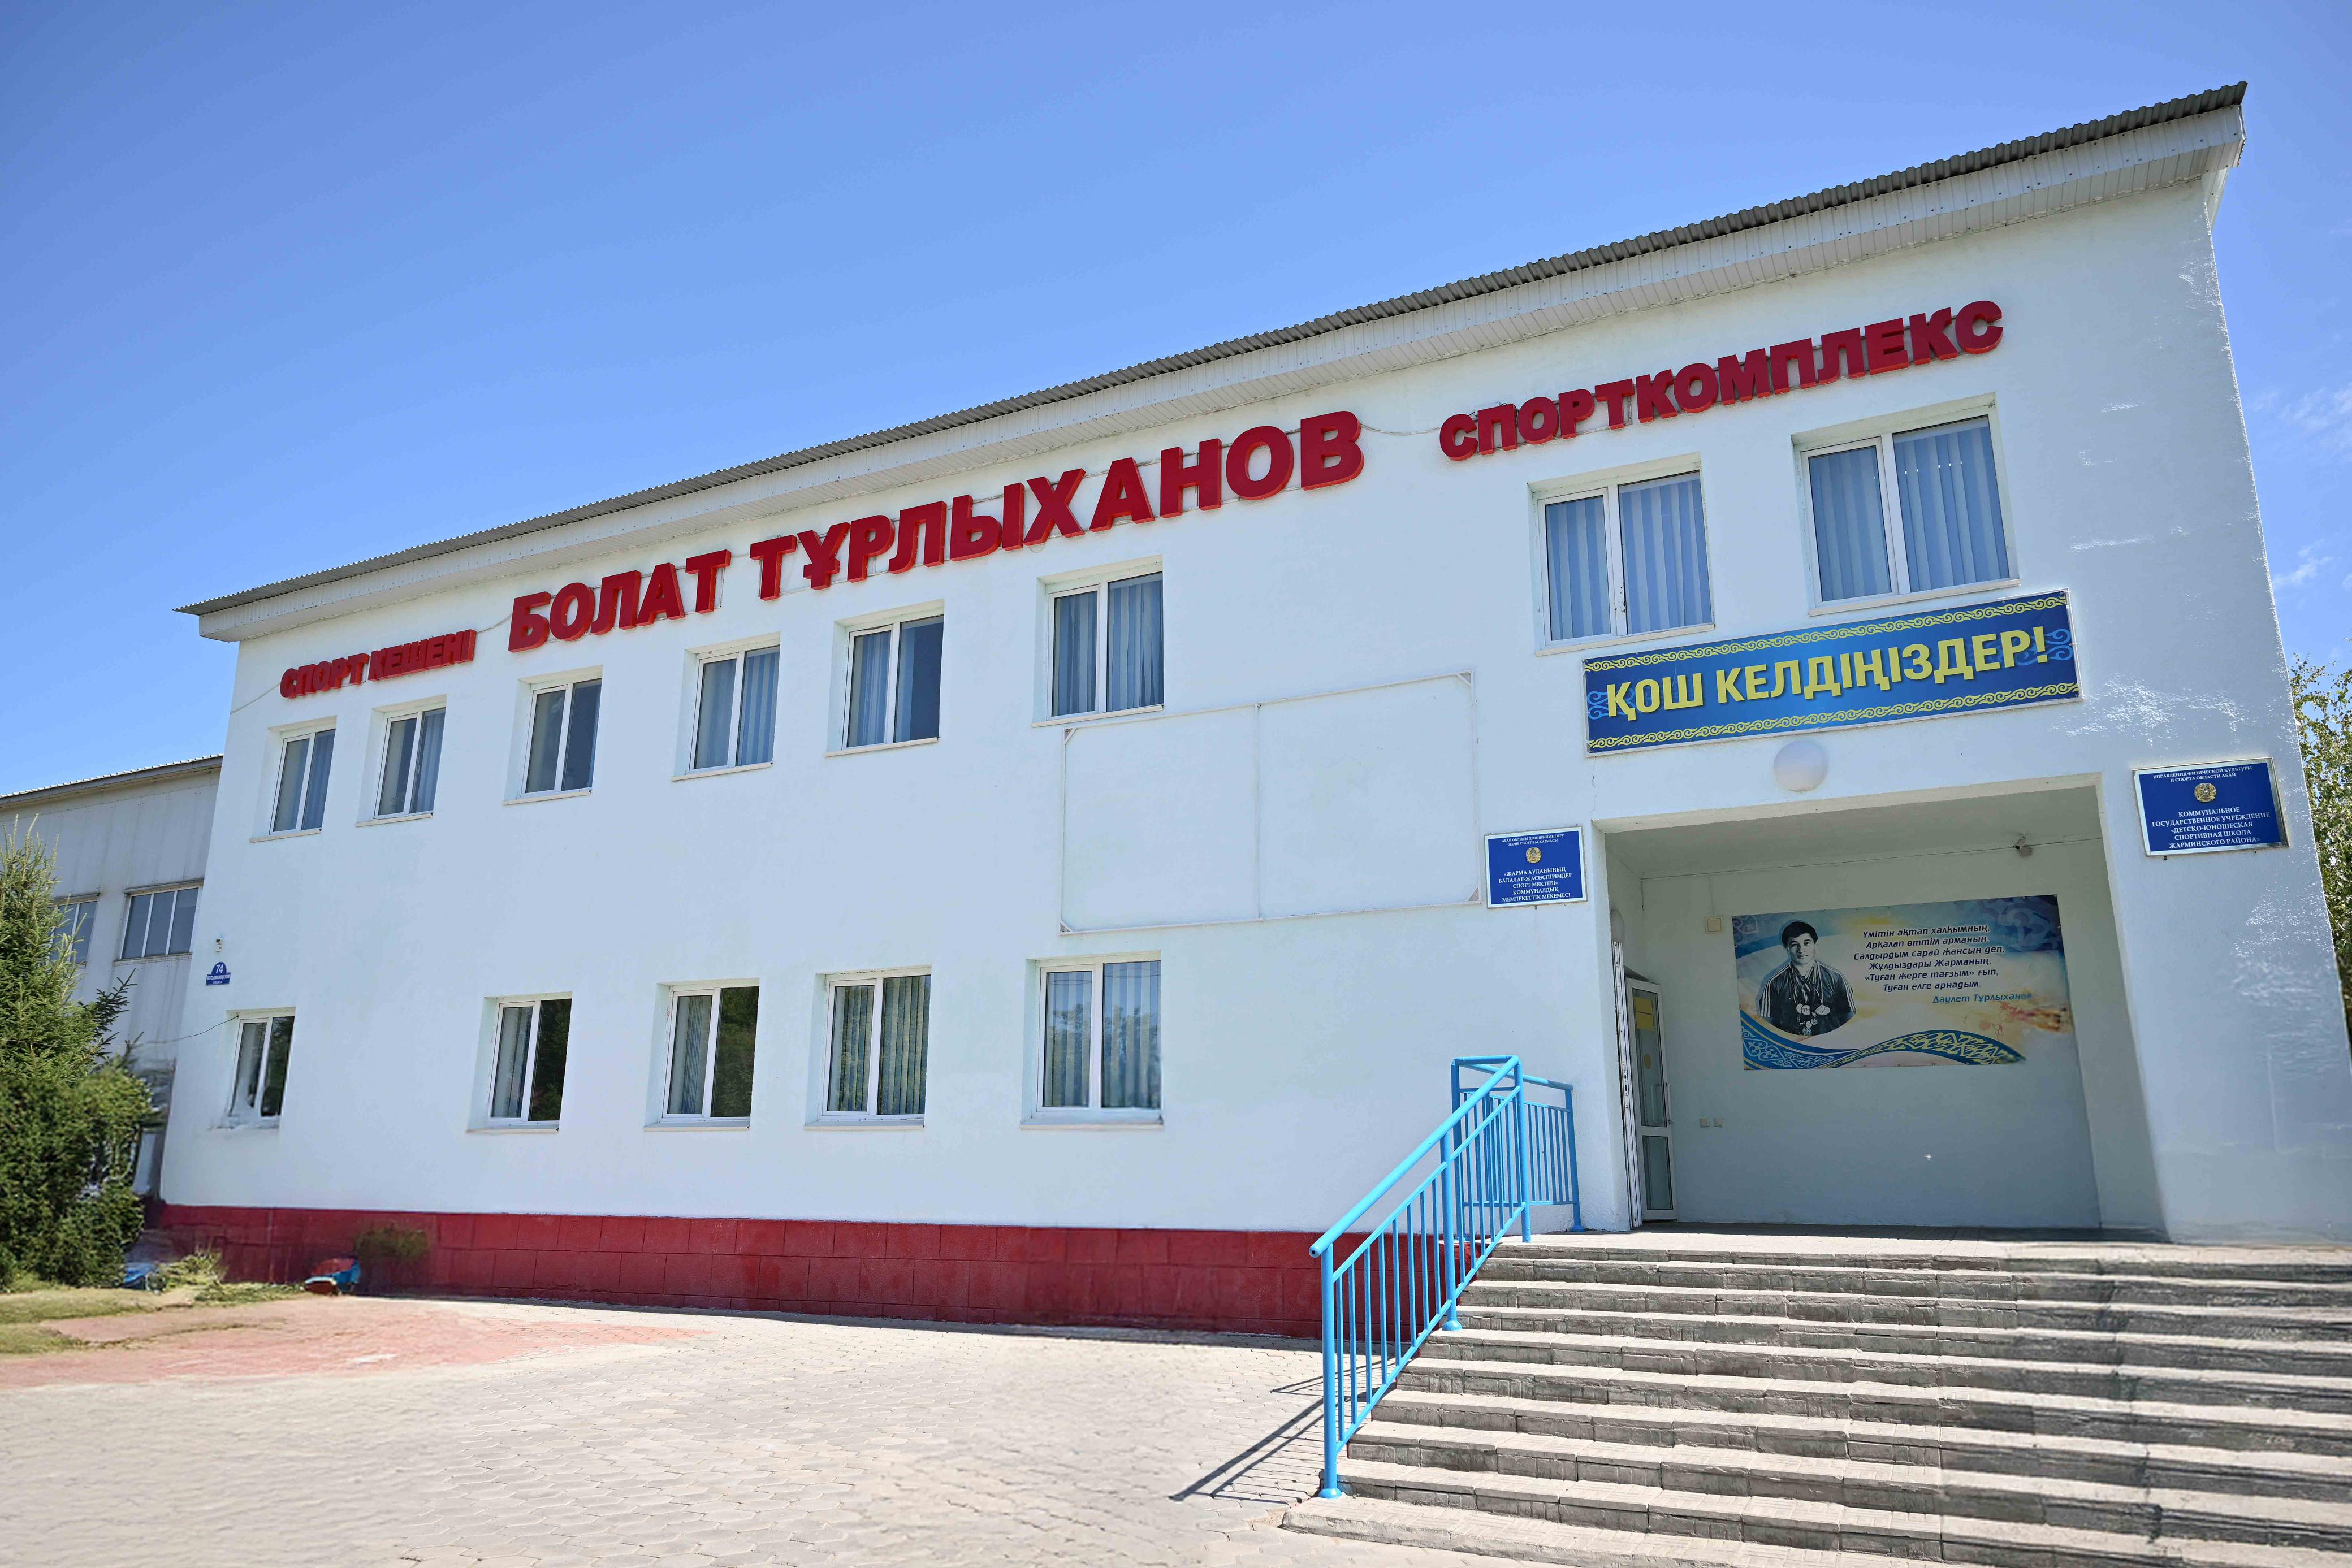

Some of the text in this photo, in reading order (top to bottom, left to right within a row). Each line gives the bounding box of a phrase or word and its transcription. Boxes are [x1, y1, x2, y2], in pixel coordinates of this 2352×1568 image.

[1439, 301, 2003, 461] СПОРТКОМПЛЕКС
[508, 410, 1365, 653] БОЛАТ ТҰРЛЫХАНОВ
[279, 629, 477, 699] СПОРТ КЕШЕНІ
[1606, 626, 2047, 722] ҚОШ КЕЛДІҢІЗДЕР!
[2178, 807, 2240, 817] КОММУНАЛЬНОЕ
[2152, 812, 2271, 827] ГОСУДАРСТВЕННОЕ УЧРЕЖДЕНИЕ
[2171, 821, 2253, 834] «ДЕТСКО-ЮНОШЕСКАЯ
[2169, 836, 2260, 848] ЖАРМИНСКОГО РАЙОНА»
[2174, 831, 2223, 841] СПОРТИВНАЯ
[1528, 867, 1566, 875] АУДАНЫНЫҢ
[1498, 873, 1572, 883] БАЛАЛАР-ЖАСӨСПІРІМДЕР
[1897, 929, 1928, 937] ақтап
[1866, 940, 1904, 950] Арқалап
[1907, 937, 1940, 947] өттім
[1853, 950, 1909, 961] Салдырдым
[1912, 948, 1939, 959] сарай
[1943, 947, 1982, 956] жансын
[216, 964, 223, 973] 74
[1869, 961, 1932, 971] Жұлдыздары
[1865, 973, 1895, 982] «Туған
[1899, 972, 1927, 981] жерге
[1930, 970, 1974, 978] тағзым»
[1883, 981, 1981, 993] Туған елге арнадым.
[1932, 995, 1970, 1004] Даулет
